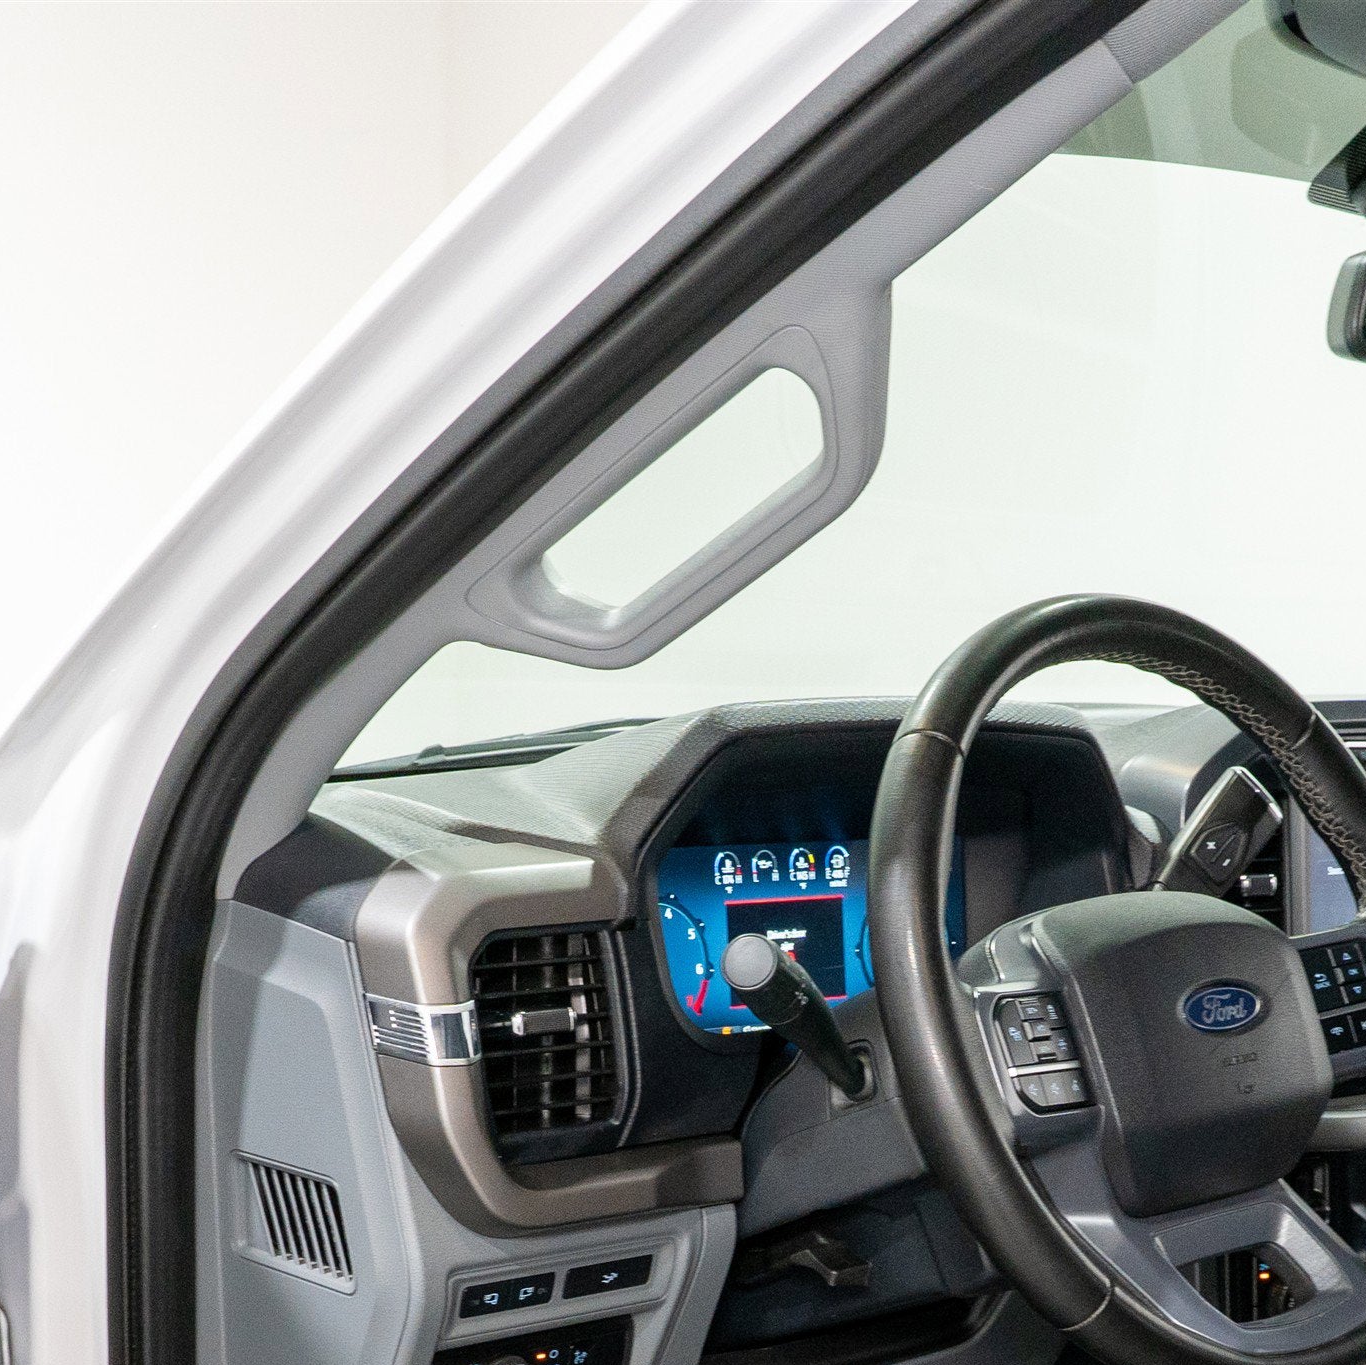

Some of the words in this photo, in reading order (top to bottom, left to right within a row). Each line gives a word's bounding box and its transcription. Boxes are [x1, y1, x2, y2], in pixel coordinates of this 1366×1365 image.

[664, 907, 673, 919] 4
[687, 927, 696, 940] 5
[695, 963, 704, 975] 6
[1202, 993, 1248, 1024] Ford
